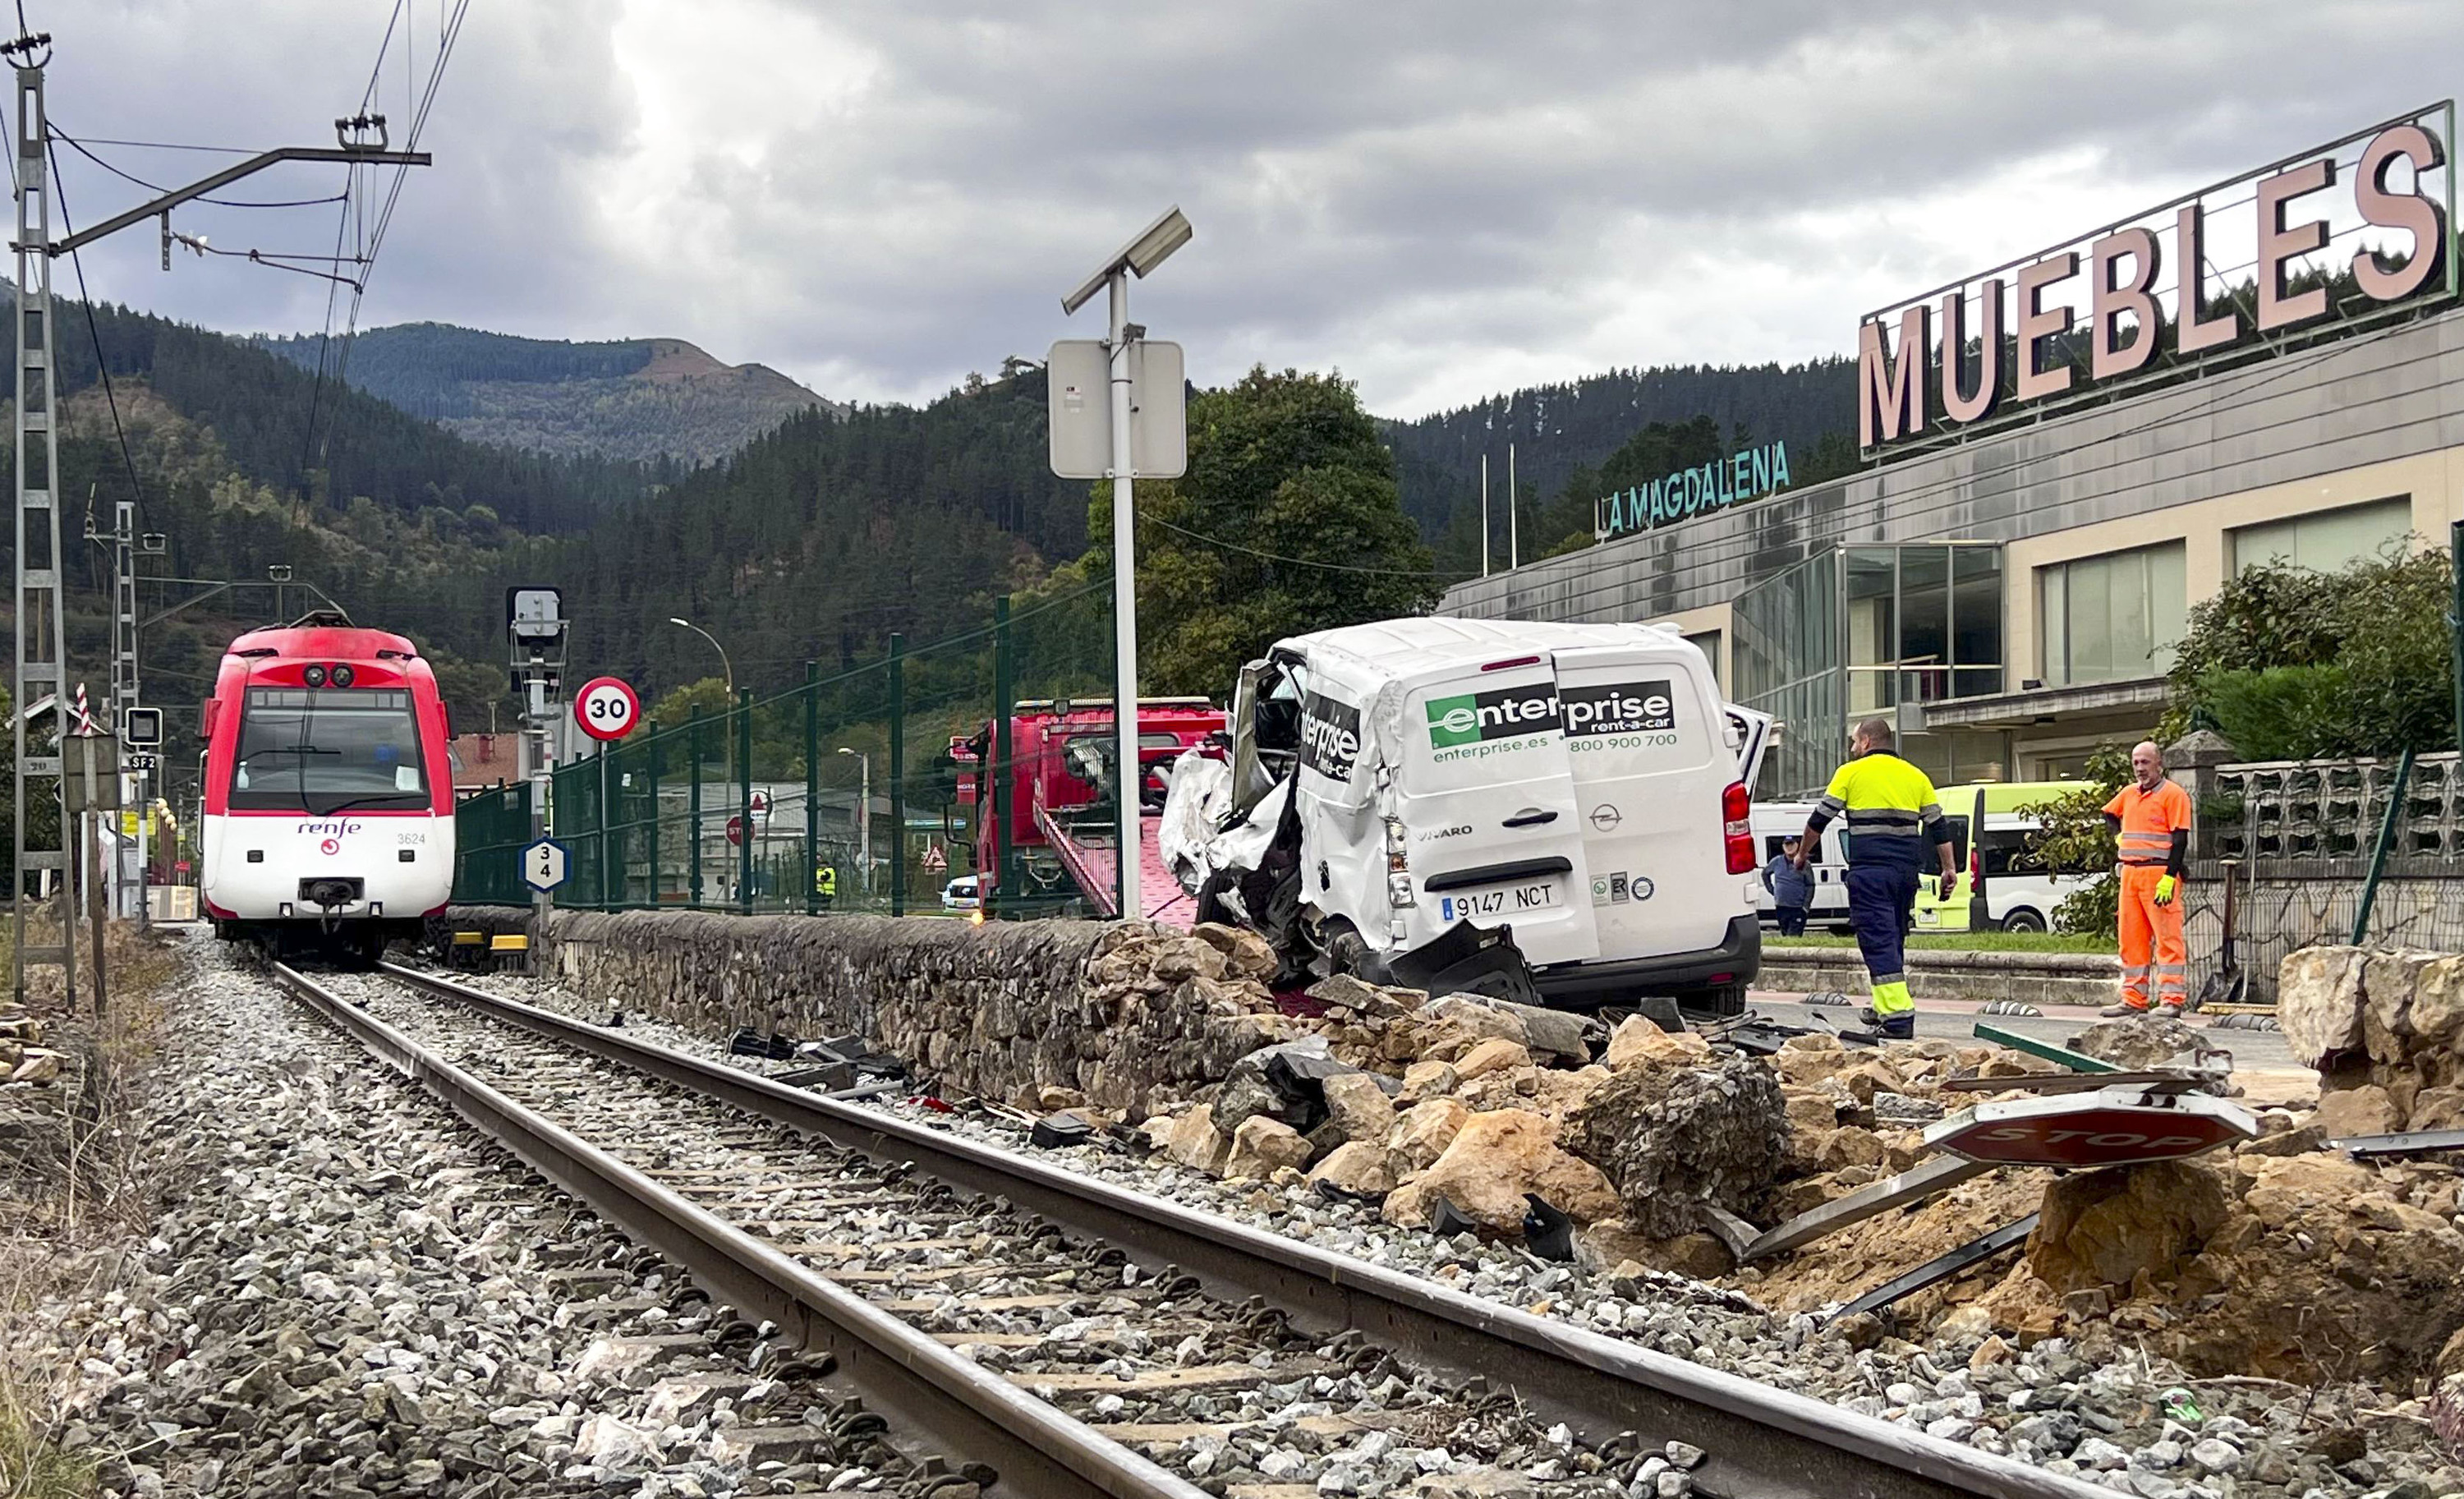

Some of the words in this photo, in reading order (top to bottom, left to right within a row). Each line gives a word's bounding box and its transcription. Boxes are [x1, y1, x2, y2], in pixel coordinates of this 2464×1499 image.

[1859, 126, 2445, 448] MUEBLES
[1594, 491, 1624, 540] LA
[1630, 440, 1791, 530] MAGDALENA
[591, 698, 625, 719] 30
[1442, 692, 1670, 733] enterprise
[1590, 717, 1670, 733] rent-a-car
[1433, 738, 1548, 763] enterprise.es
[1570, 740, 1603, 752] 800
[1607, 737, 1641, 749] 900
[1644, 733, 1677, 746] 700
[297, 817, 361, 839] renfe
[398, 834, 425, 844] 3624
[540, 846, 550, 860] 3
[540, 863, 551, 878] 4
[1457, 891, 1504, 916] 9147
[1515, 884, 1551, 908] NCT
[1975, 1128, 2204, 1148] STOP
